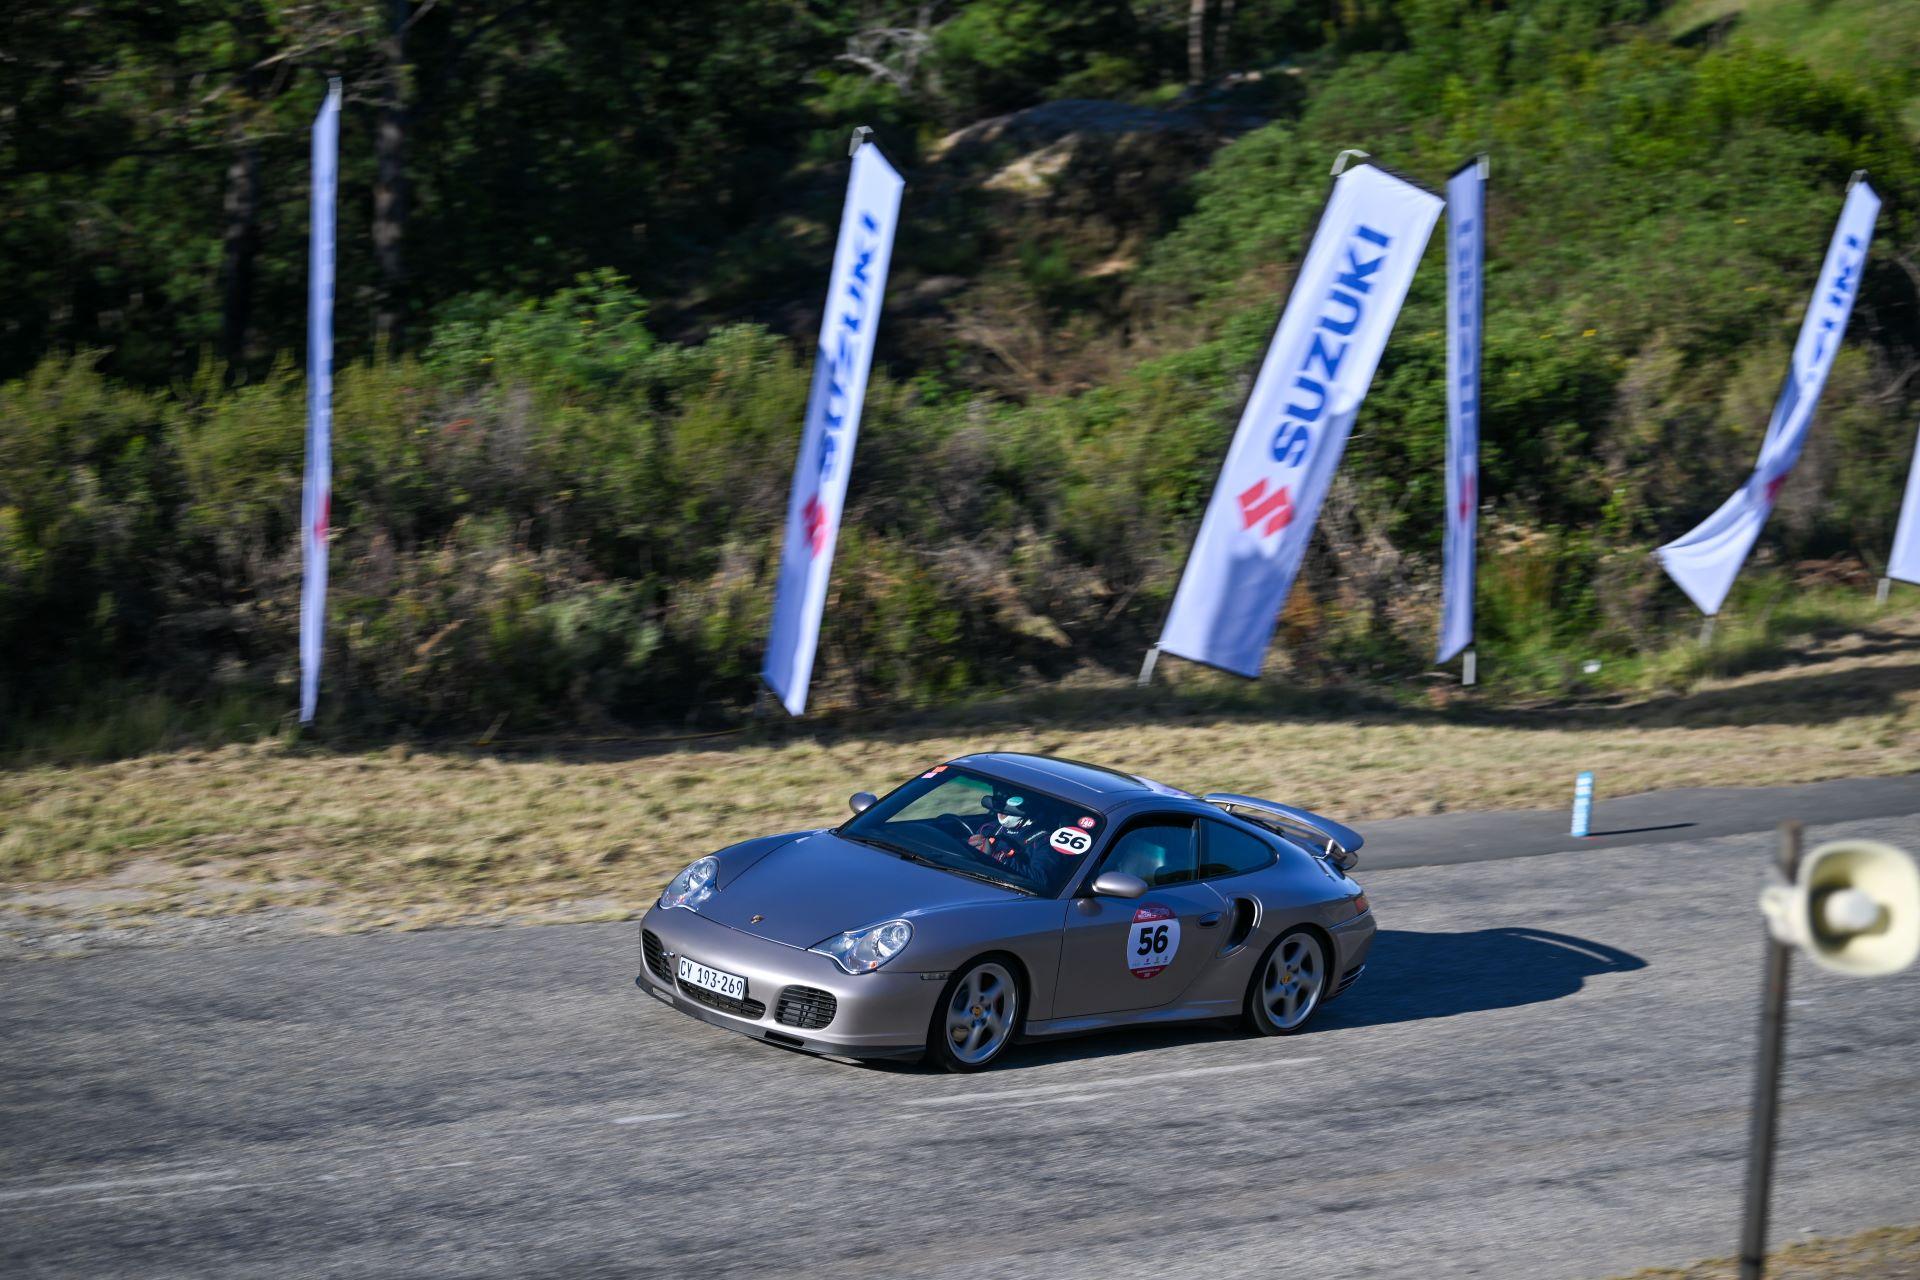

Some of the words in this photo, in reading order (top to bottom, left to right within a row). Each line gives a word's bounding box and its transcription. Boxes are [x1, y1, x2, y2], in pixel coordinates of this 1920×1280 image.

[1269, 223, 1394, 469] SUZUKI
[1055, 831, 1087, 850] 56
[1137, 925, 1168, 955] 56
[680, 960, 693, 979] CY
[696, 967, 743, 996] 193-269
